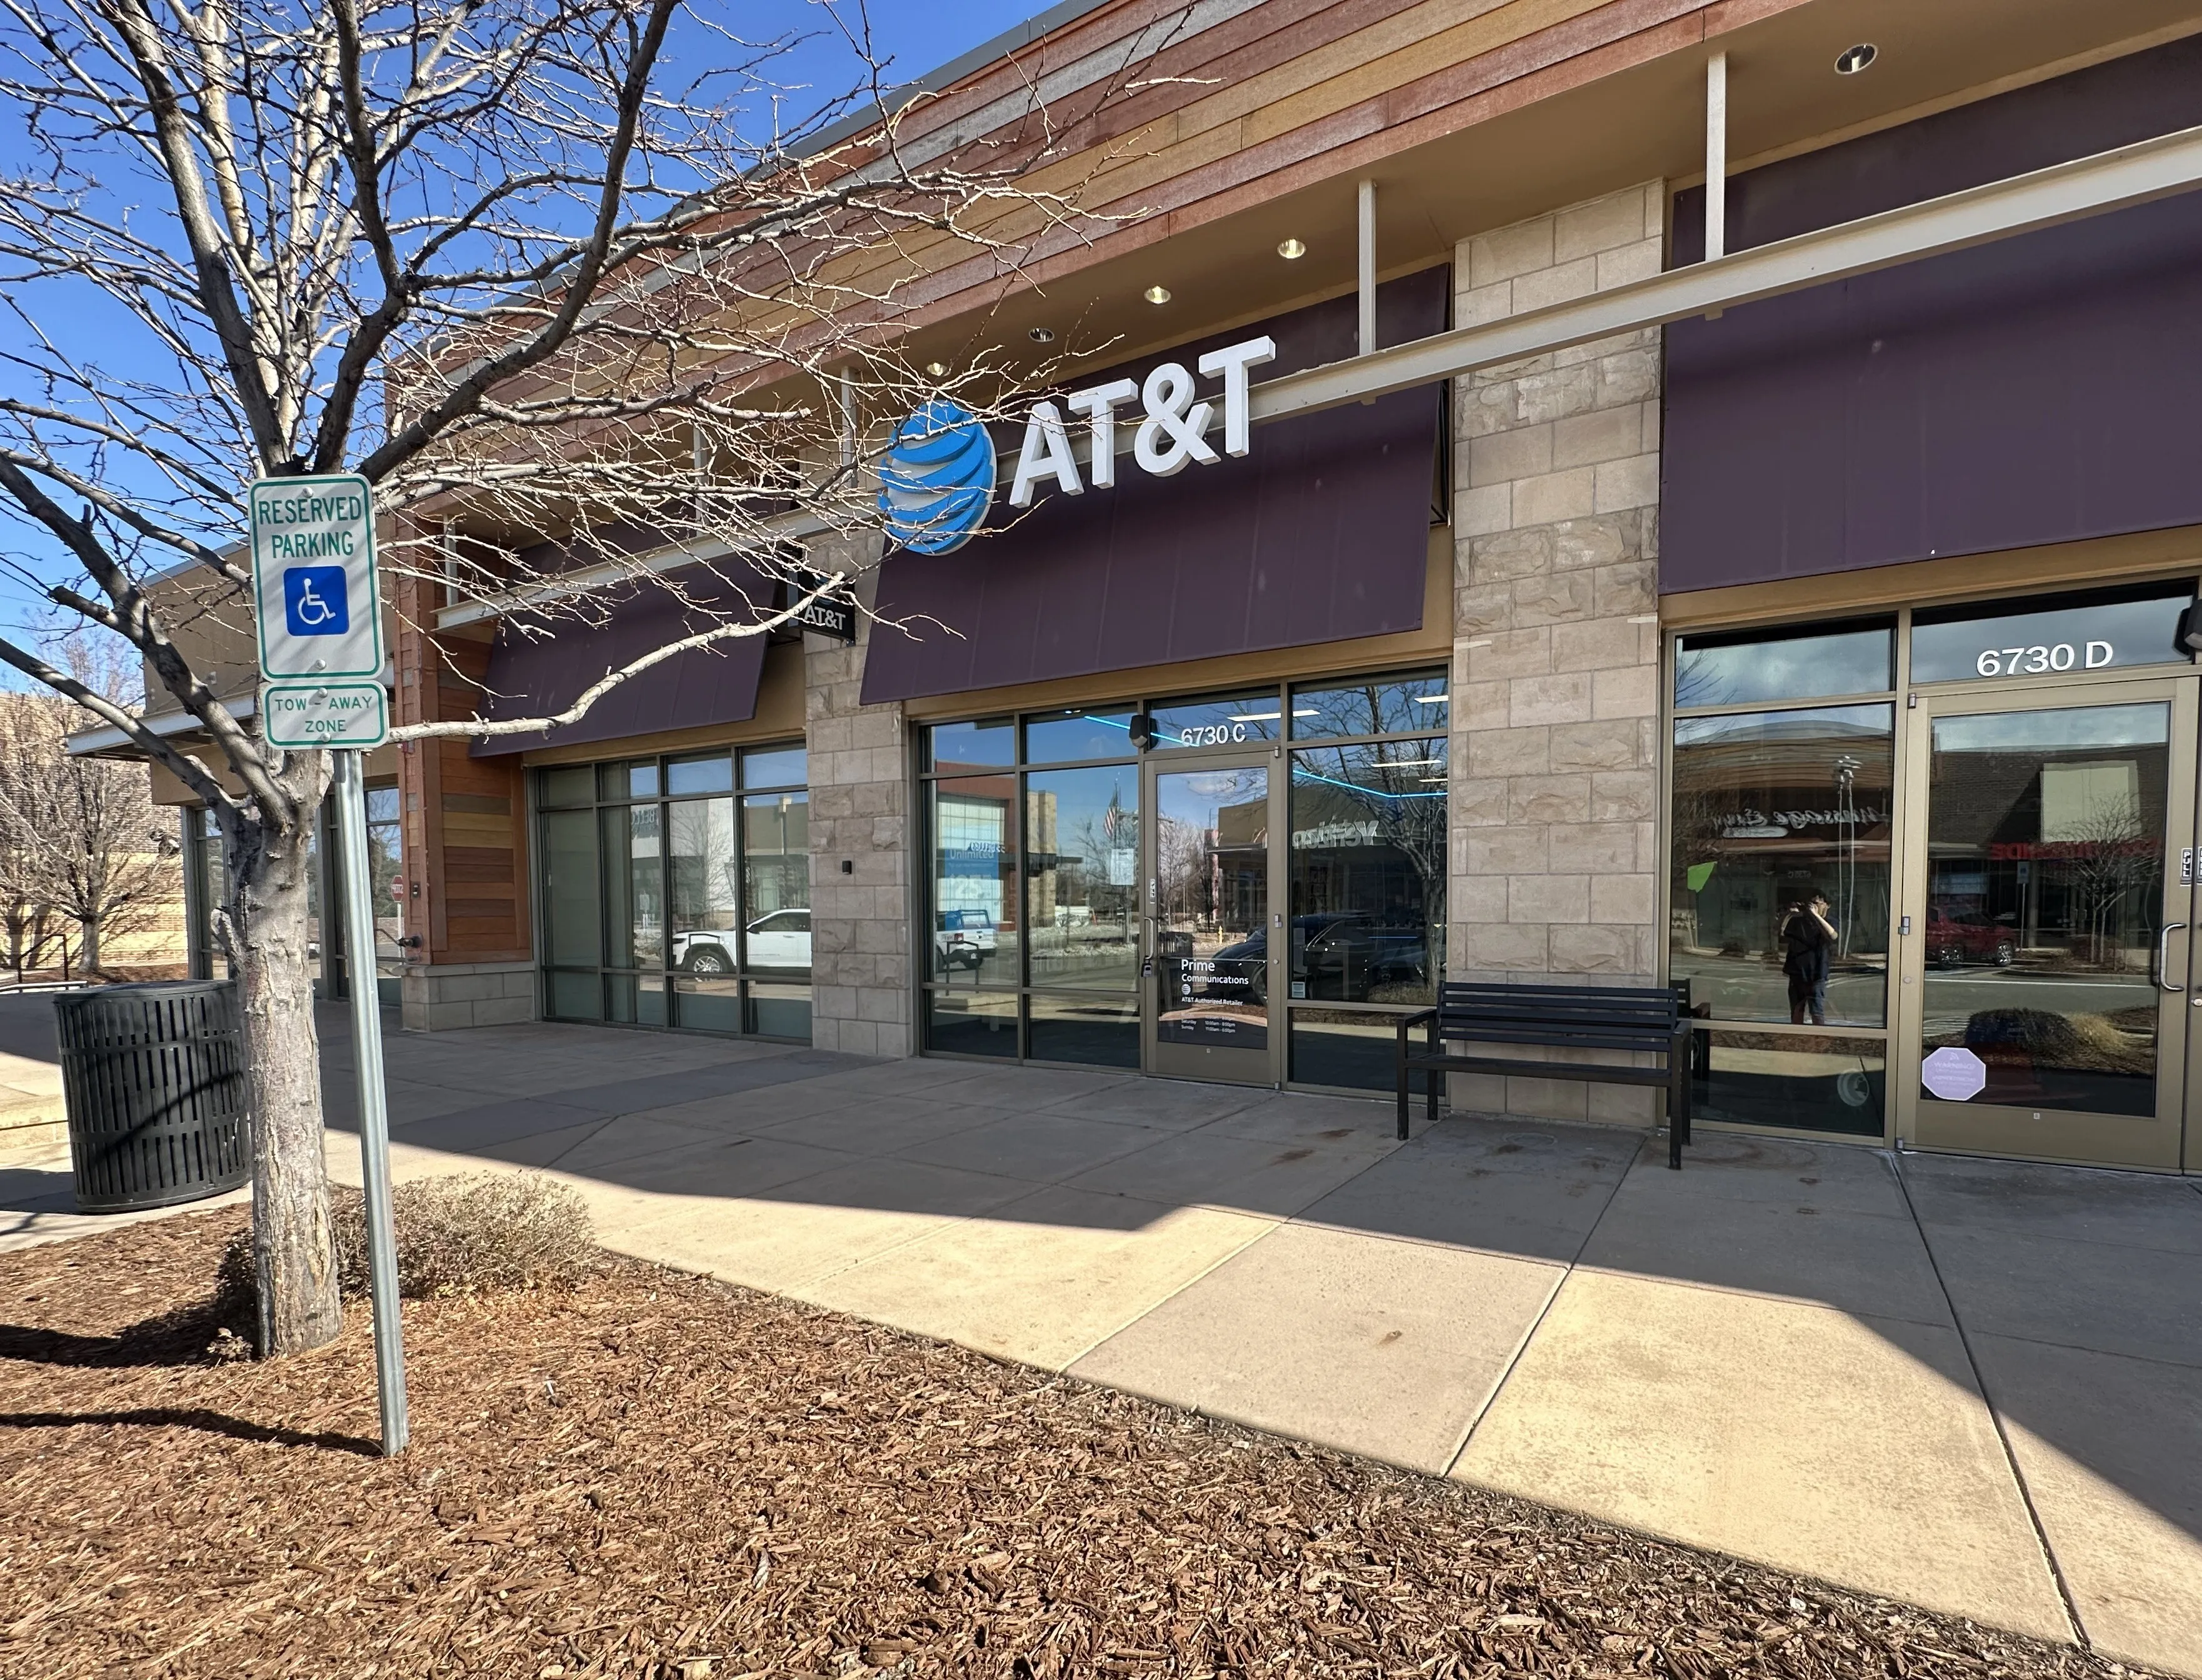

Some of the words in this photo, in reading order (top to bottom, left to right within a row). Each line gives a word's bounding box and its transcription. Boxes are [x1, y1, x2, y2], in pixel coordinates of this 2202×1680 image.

[1009, 335, 1276, 508] AT&T
[258, 496, 361, 525] RESERVED
[271, 531, 354, 558] PARKING
[804, 604, 846, 630] AT&T
[1976, 643, 2074, 677] 6730
[2085, 641, 2113, 669] D
[274, 698, 306, 711] TOW
[328, 696, 373, 710] AWAY
[305, 720, 347, 733] ZONE
[1181, 725, 1229, 747] 6730
[1233, 723, 1246, 742] C
[950, 849, 994, 859] Unlimited
[2183, 851, 2191, 877] PULL
[1181, 959, 1215, 972] Prime
[1181, 974, 1249, 985] Communications
